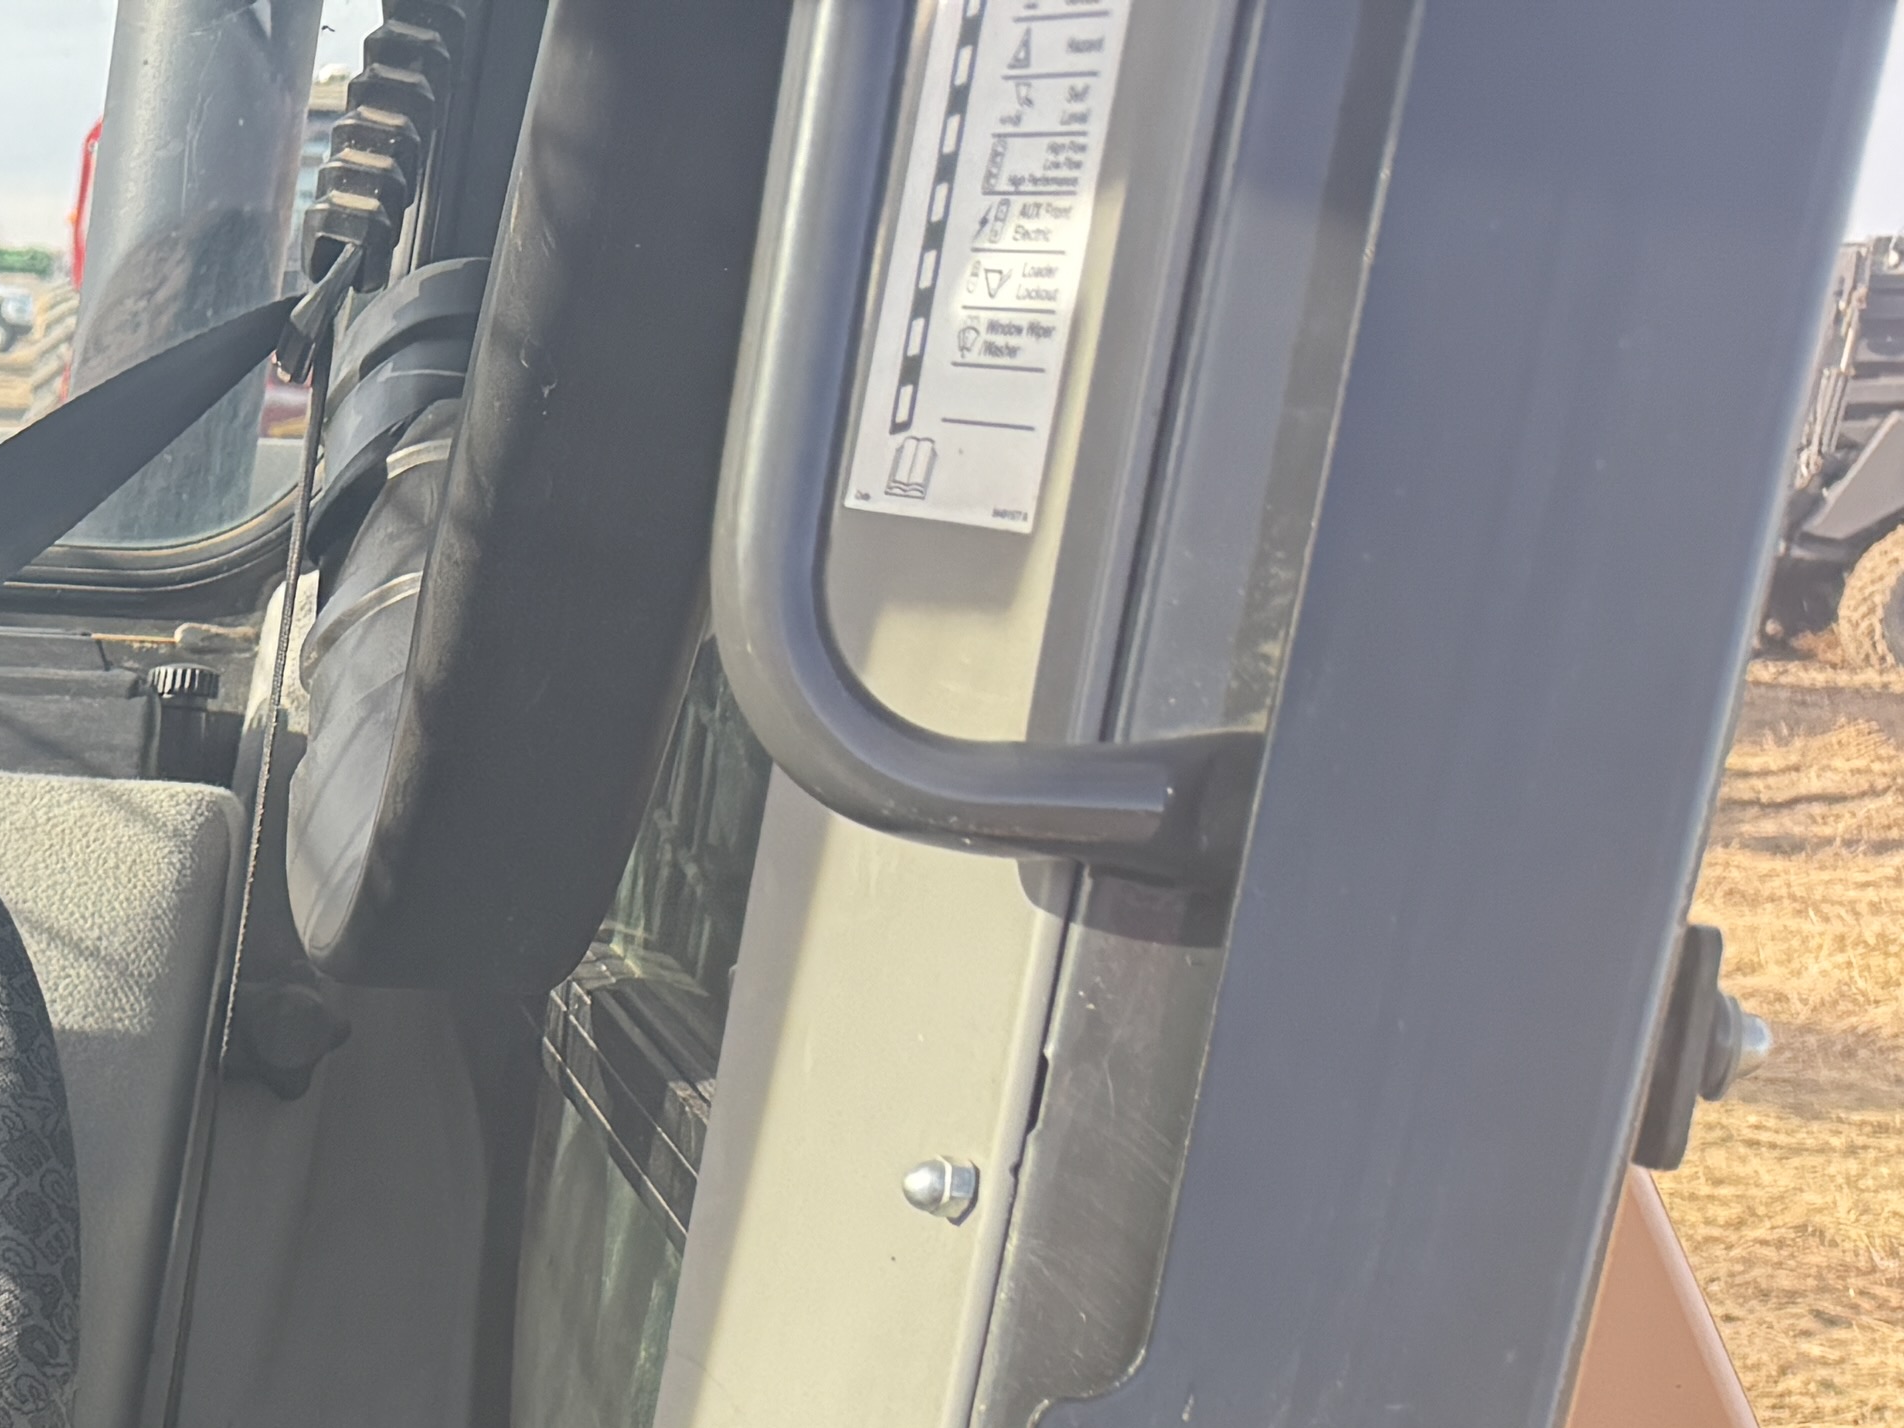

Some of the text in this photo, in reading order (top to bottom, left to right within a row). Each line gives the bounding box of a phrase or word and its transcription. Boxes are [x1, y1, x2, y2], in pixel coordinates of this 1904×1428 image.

[1021, 262, 1059, 279] Loader
[1016, 283, 1061, 302] Lockout
[985, 319, 1056, 341] Window Wiper
